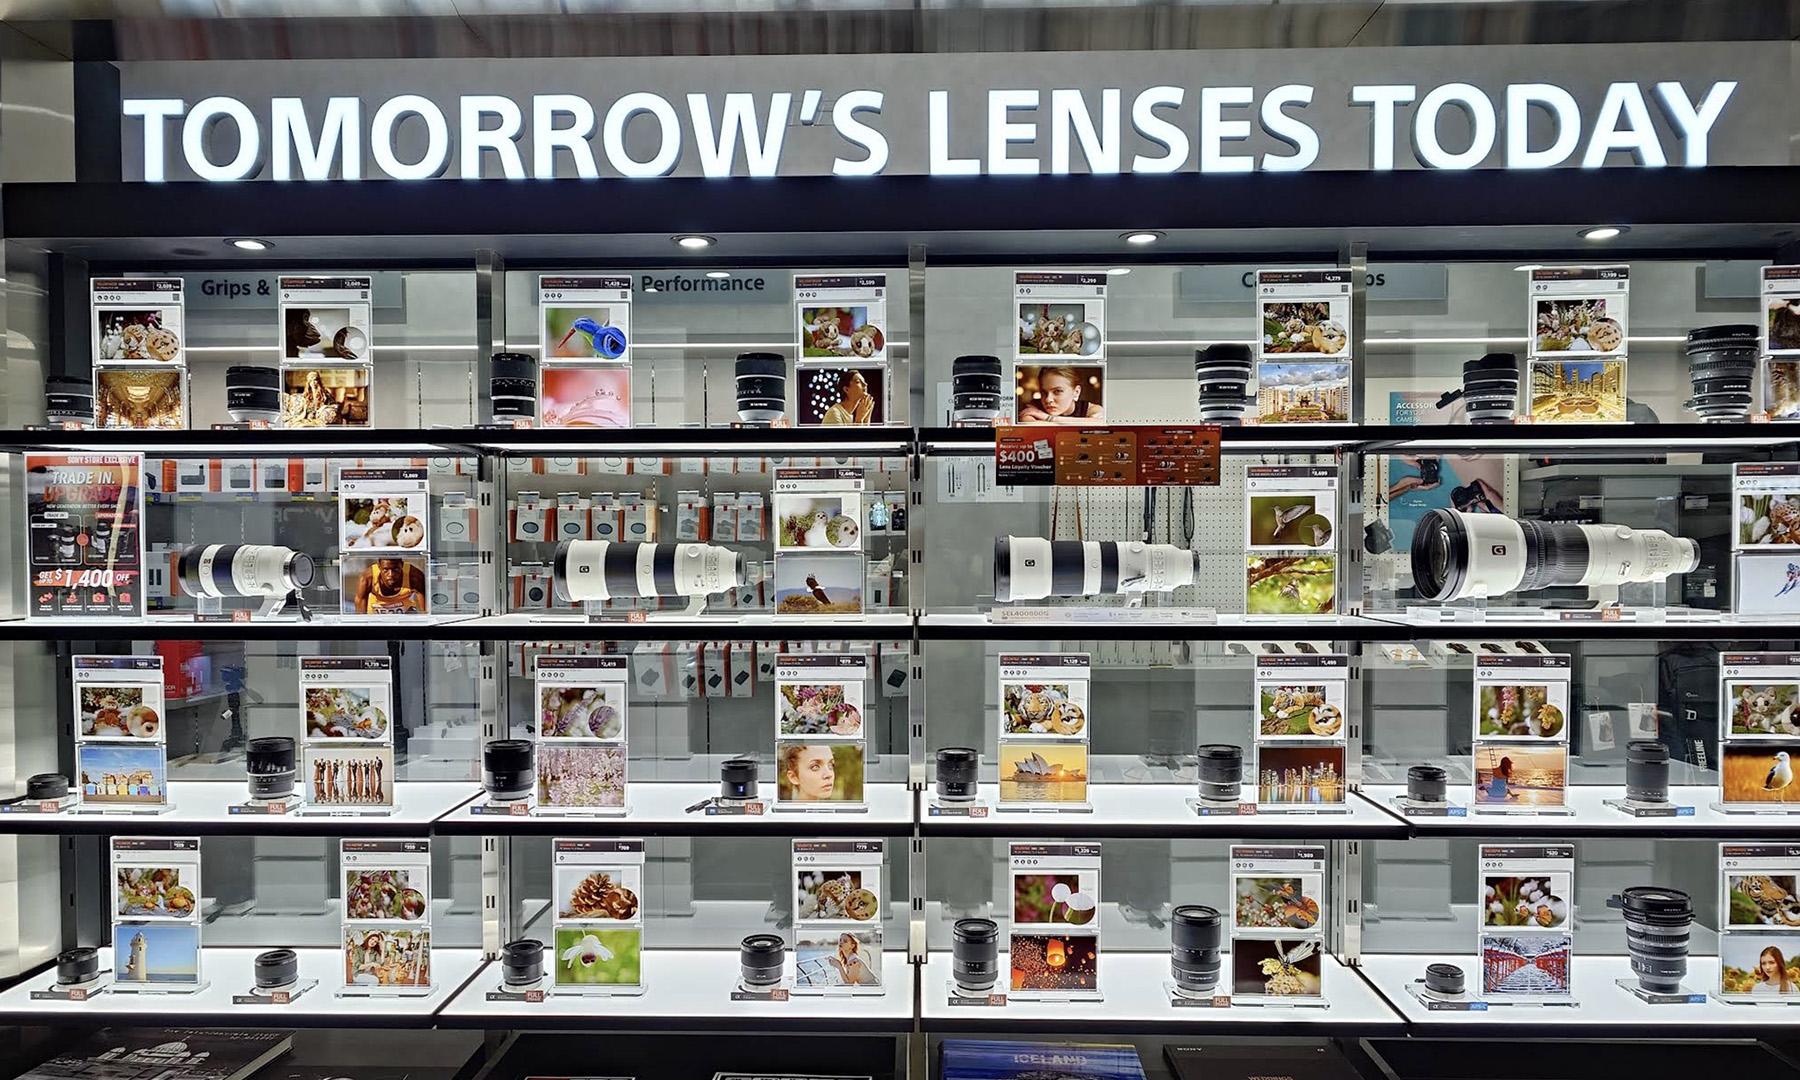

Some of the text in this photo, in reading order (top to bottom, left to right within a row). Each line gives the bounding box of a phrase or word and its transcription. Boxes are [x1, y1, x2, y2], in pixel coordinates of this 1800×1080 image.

[122, 81, 1738, 182] TOMORROW'S LENSES TODAY
[201, 279, 251, 299] Grips
[256, 279, 270, 296] &
[641, 275, 765, 292] Performance
[1000, 450, 1035, 463] $400
[52, 472, 115, 485] TRADE IN.
[43, 486, 122, 502] UPGRADE
[1494, 546, 1504, 555] G
[39, 571, 52, 579] GET
[1014, 1054, 1087, 1066] ICELAND
